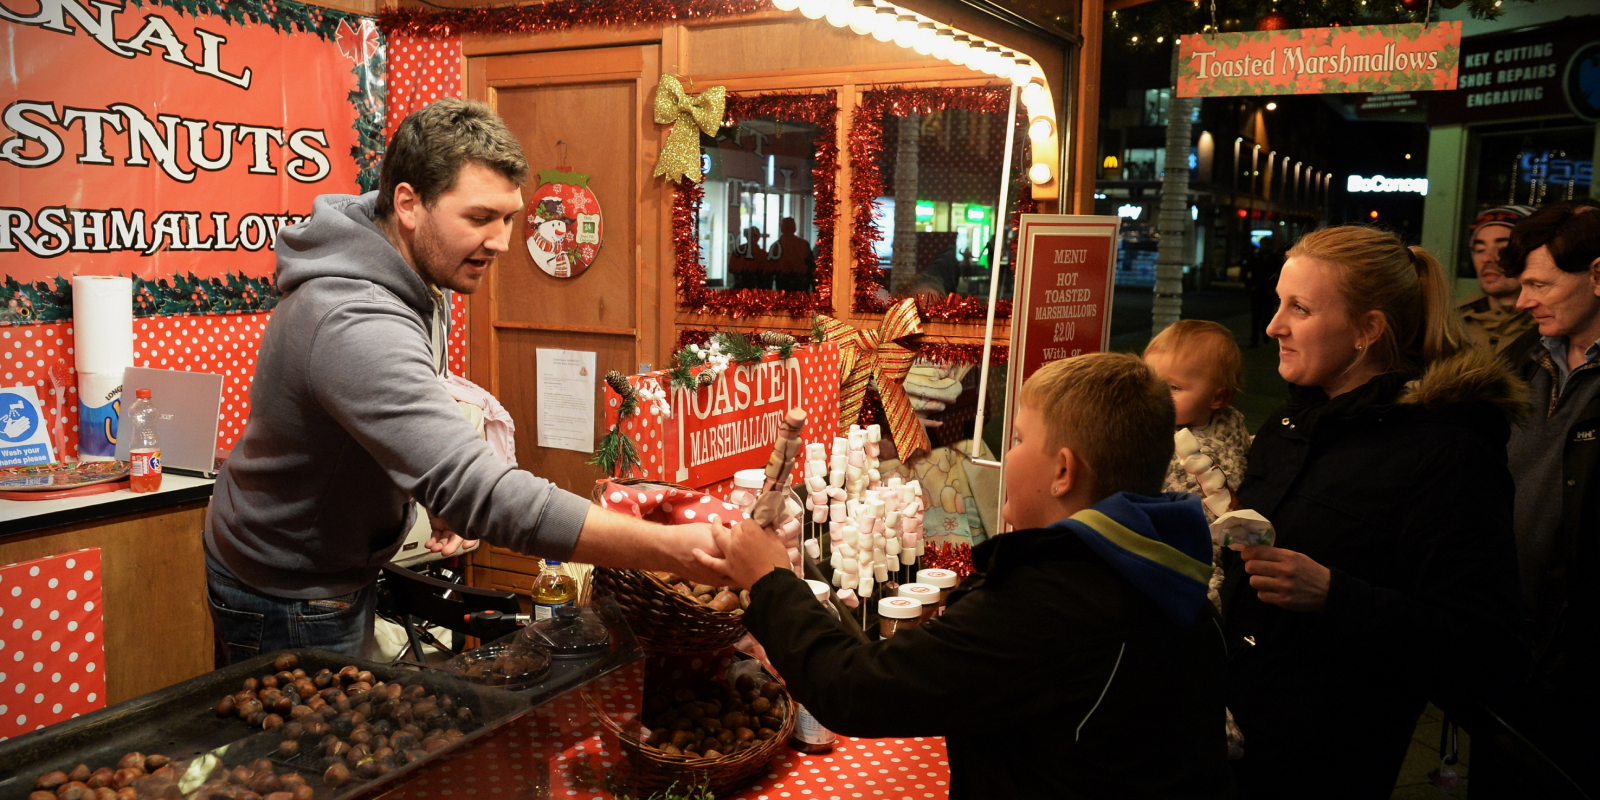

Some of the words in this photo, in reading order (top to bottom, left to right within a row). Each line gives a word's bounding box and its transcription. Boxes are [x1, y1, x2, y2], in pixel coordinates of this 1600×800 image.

[1191, 48, 1276, 79] Toasted
[1282, 41, 1438, 76] Marshmallows
[1464, 52, 1490, 68] KEY
[1494, 42, 1553, 64] CUTTING
[1458, 72, 1492, 89] SHOE
[1497, 63, 1556, 84] REPAIRS
[1466, 86, 1544, 108] ENGRAVING
[0, 100, 330, 182] STNUTS
[0, 205, 311, 258] RSHMALLOW
[1054, 249, 1087, 264] MENU
[1056, 272, 1079, 287] HOT
[1045, 288, 1091, 303] TOASTED
[1035, 304, 1097, 320] MARSHMALLOWS
[1053, 321, 1075, 342] £2.00
[1042, 347, 1067, 360] With
[1071, 348, 1082, 357] or
[670, 356, 802, 483] TOASTED
[690, 409, 784, 467] MARSHMALLOWS
[0, 457, 22, 467] hands
[22, 455, 47, 465] please
[1, 448, 23, 457] Wash
[23, 447, 40, 456] your
